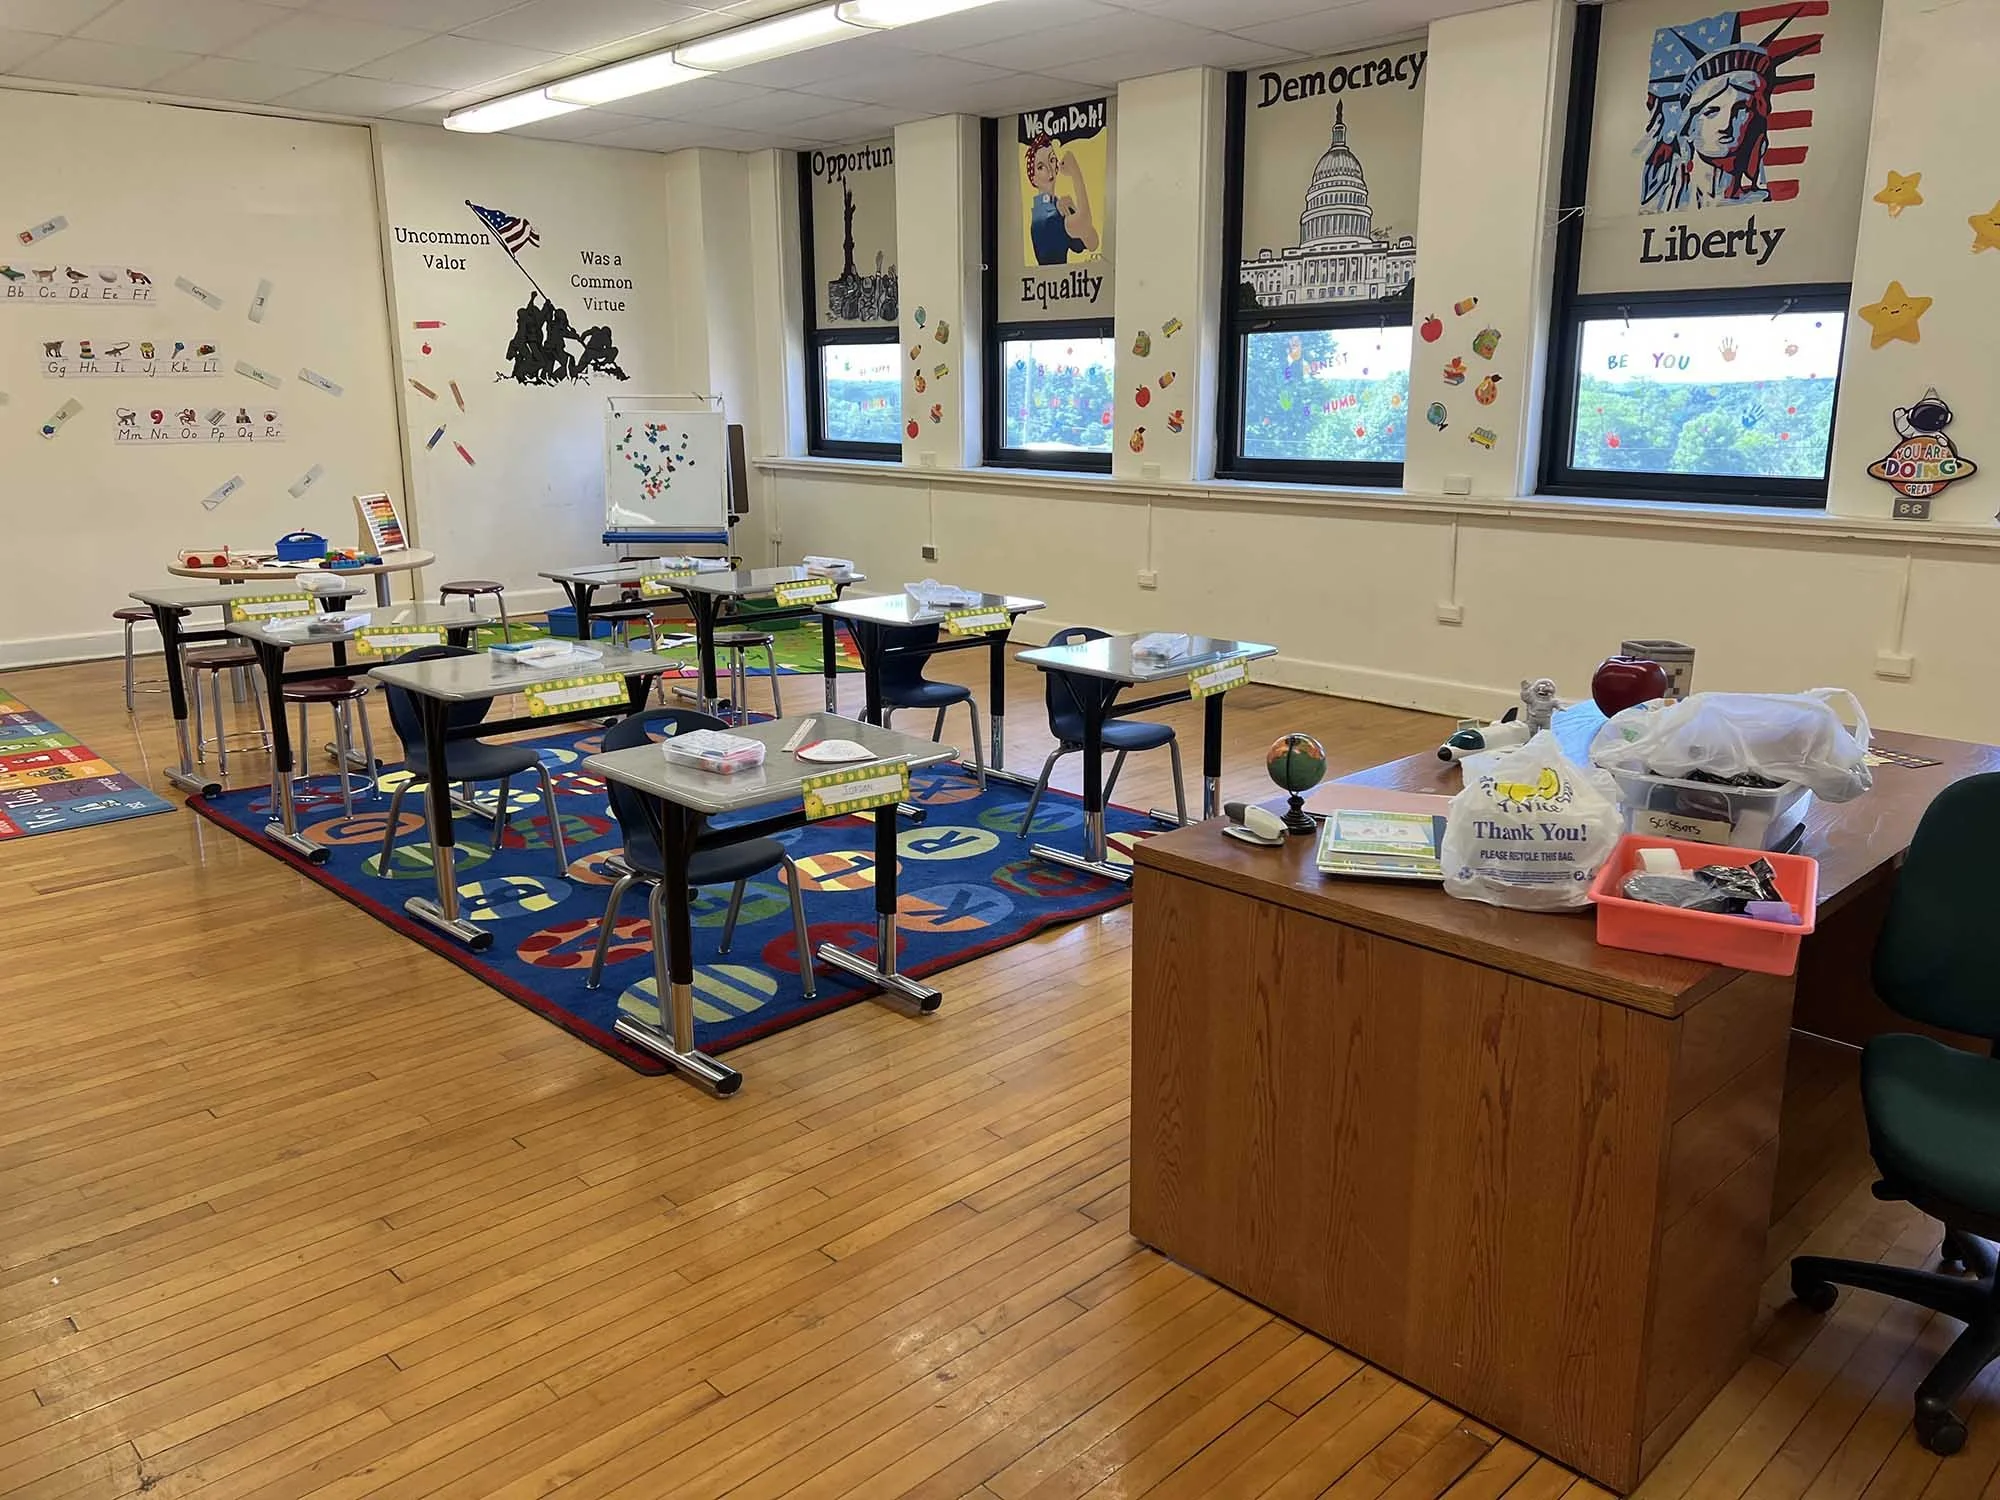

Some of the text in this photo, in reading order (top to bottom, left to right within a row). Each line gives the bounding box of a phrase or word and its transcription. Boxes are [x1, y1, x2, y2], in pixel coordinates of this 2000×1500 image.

[1257, 51, 1428, 109] Democracy
[1024, 103, 1103, 139] We Can Do It!
[394, 227, 490, 246] Uncommon
[1640, 214, 1786, 266] Liberty
[423, 255, 466, 270] Valor
[581, 251, 622, 266] Was a
[570, 274, 633, 290] Common
[1021, 268, 1103, 310] Equality
[583, 297, 626, 312] Virtue
[1608, 351, 1691, 370] BE YOU
[1896, 445, 1921, 460] YOU
[1885, 458, 1957, 478] DOING
[1905, 484, 1933, 496] GREAT
[1473, 821, 1587, 842] Thank You!
[1480, 849, 1509, 860] PLEASE
[1541, 852, 1557, 861] THIS
